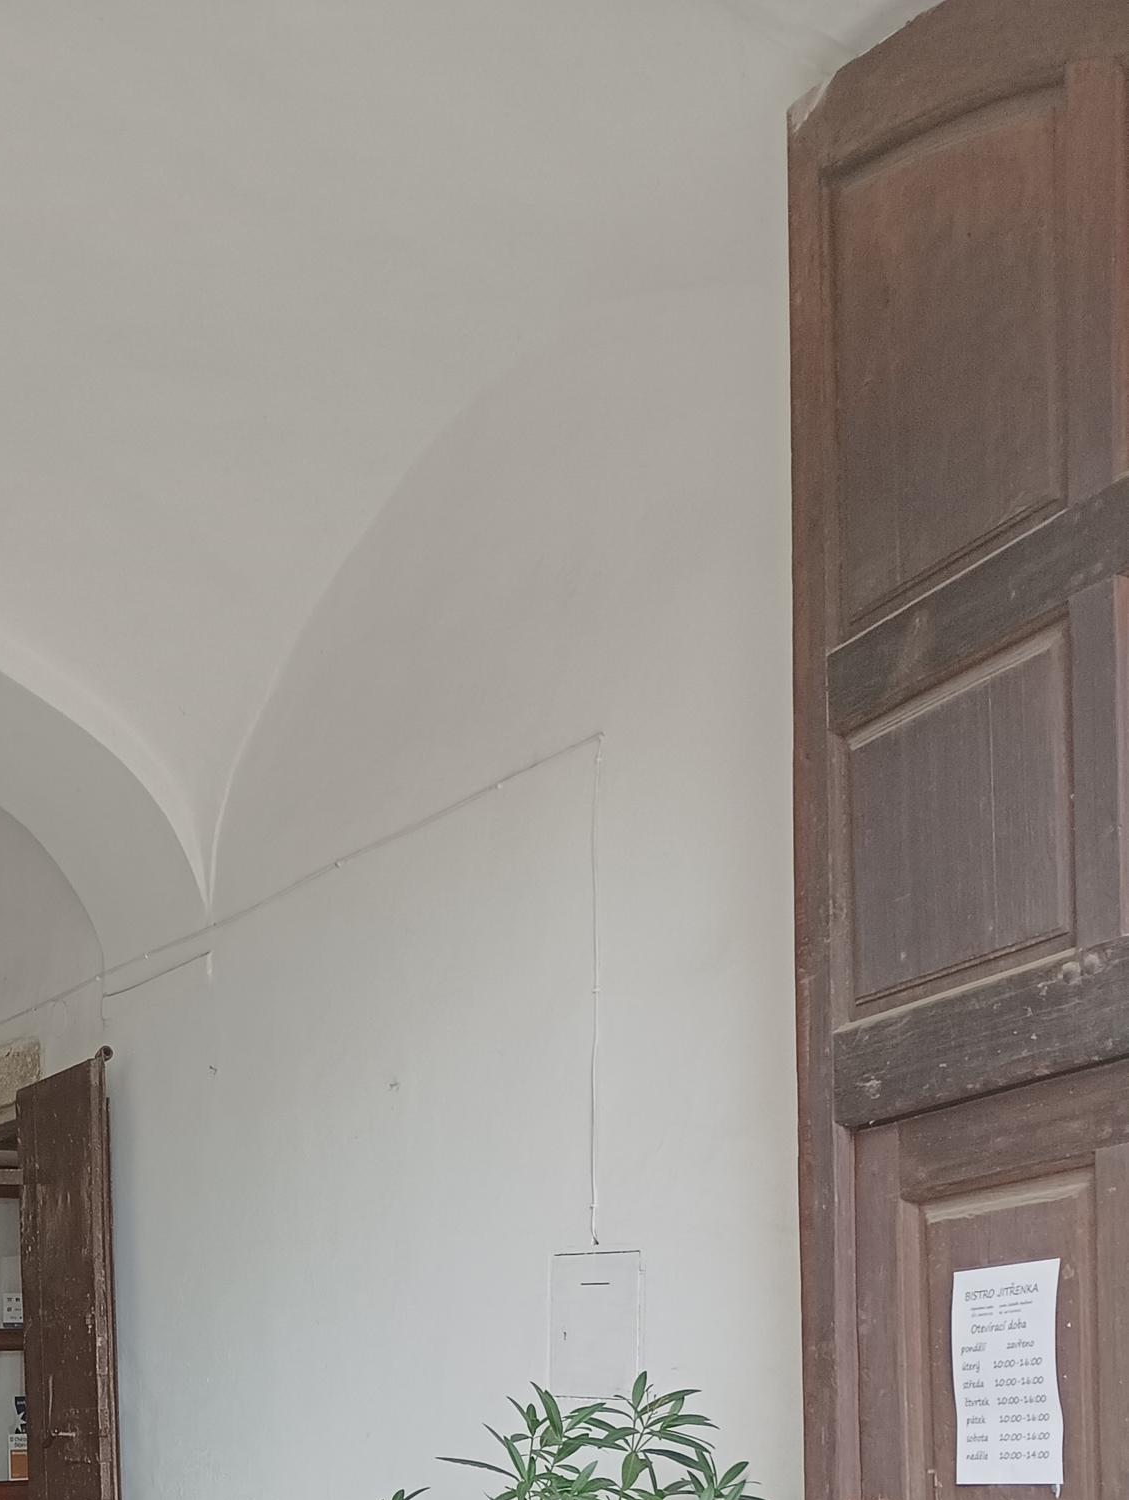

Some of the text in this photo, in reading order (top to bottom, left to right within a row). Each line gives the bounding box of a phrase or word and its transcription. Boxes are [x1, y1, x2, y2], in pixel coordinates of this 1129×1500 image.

[964, 1282, 1039, 1302] BISTRO JITŘENKA
[971, 1318, 1027, 1335] Otevírací doba
[961, 1339, 1035, 1356] pondělí zavřeno
[962, 1361, 980, 1373] úterý
[963, 1379, 984, 1390] středa
[966, 1415, 986, 1427] pátek
[966, 1432, 989, 1442] sobota
